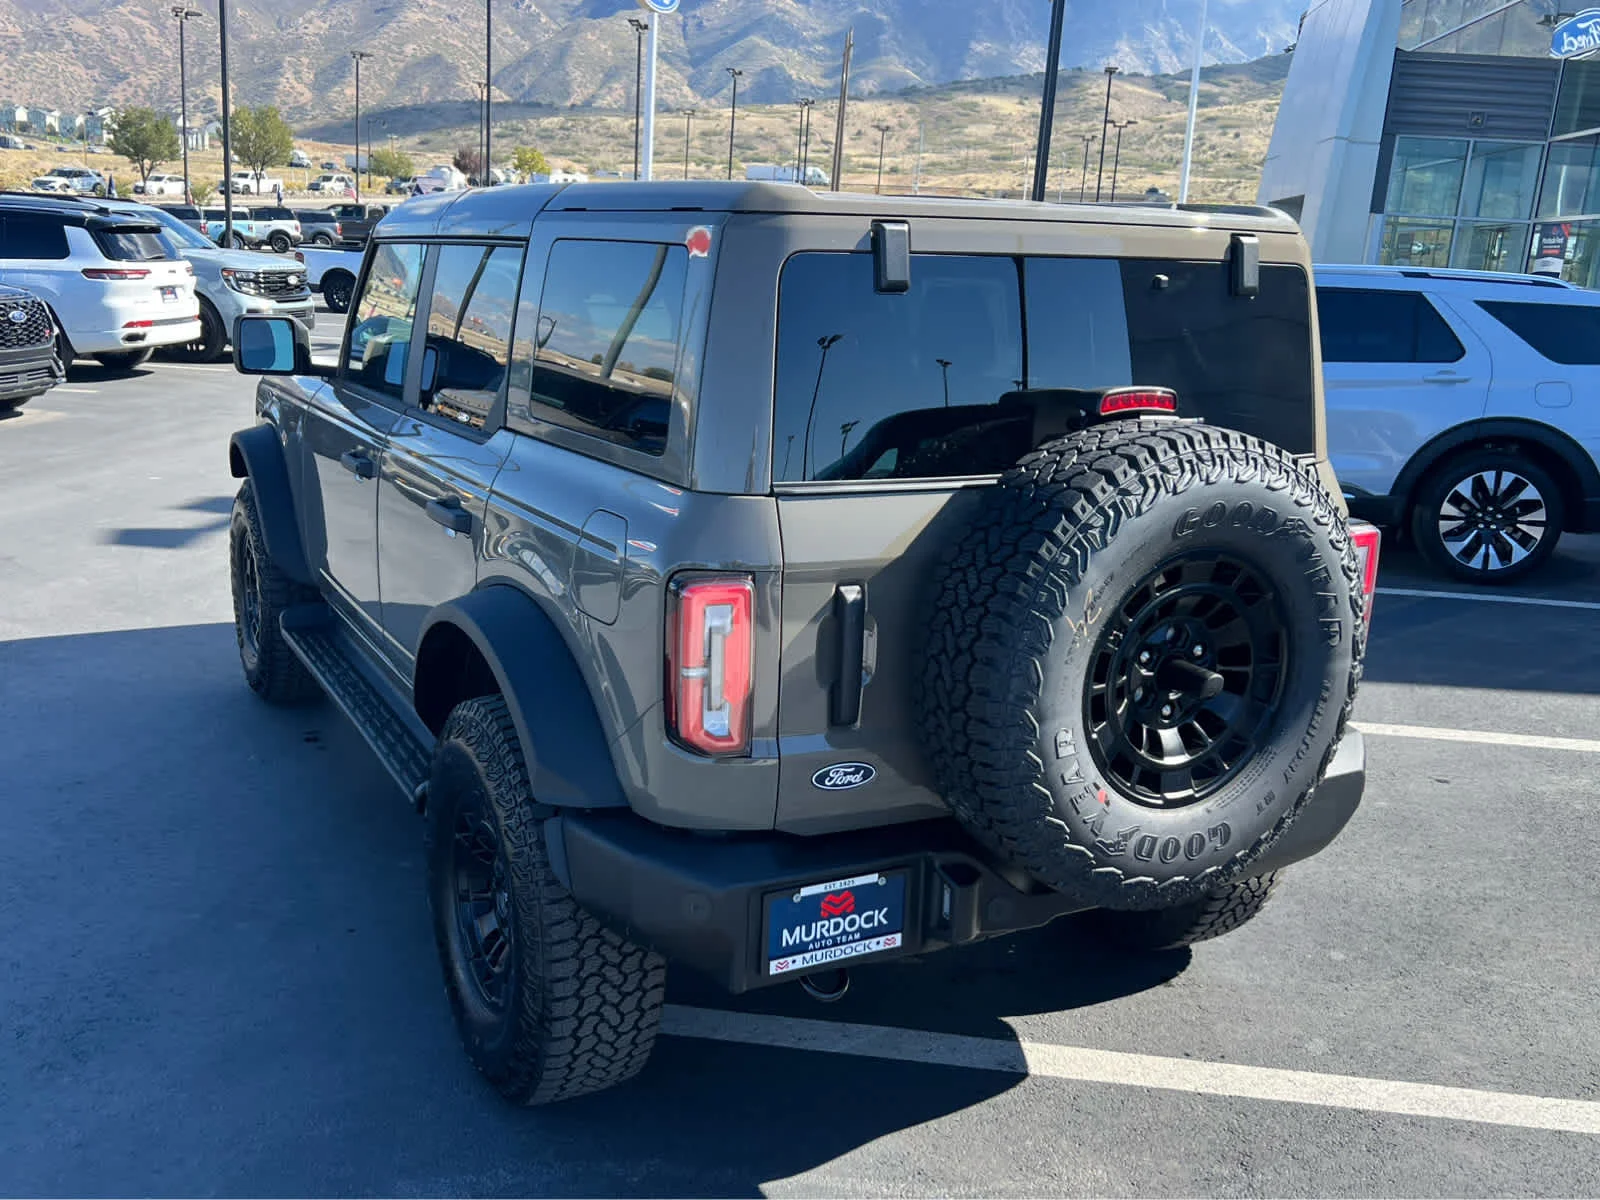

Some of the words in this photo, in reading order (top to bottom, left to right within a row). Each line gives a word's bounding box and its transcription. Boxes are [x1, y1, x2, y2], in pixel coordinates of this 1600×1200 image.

[825, 767, 864, 785] Ford
[782, 907, 888, 947] MURDOCK
[808, 939, 832, 950] AUTO
[836, 932, 861, 944] TEAM
[801, 940, 872, 965] MURDOCK
